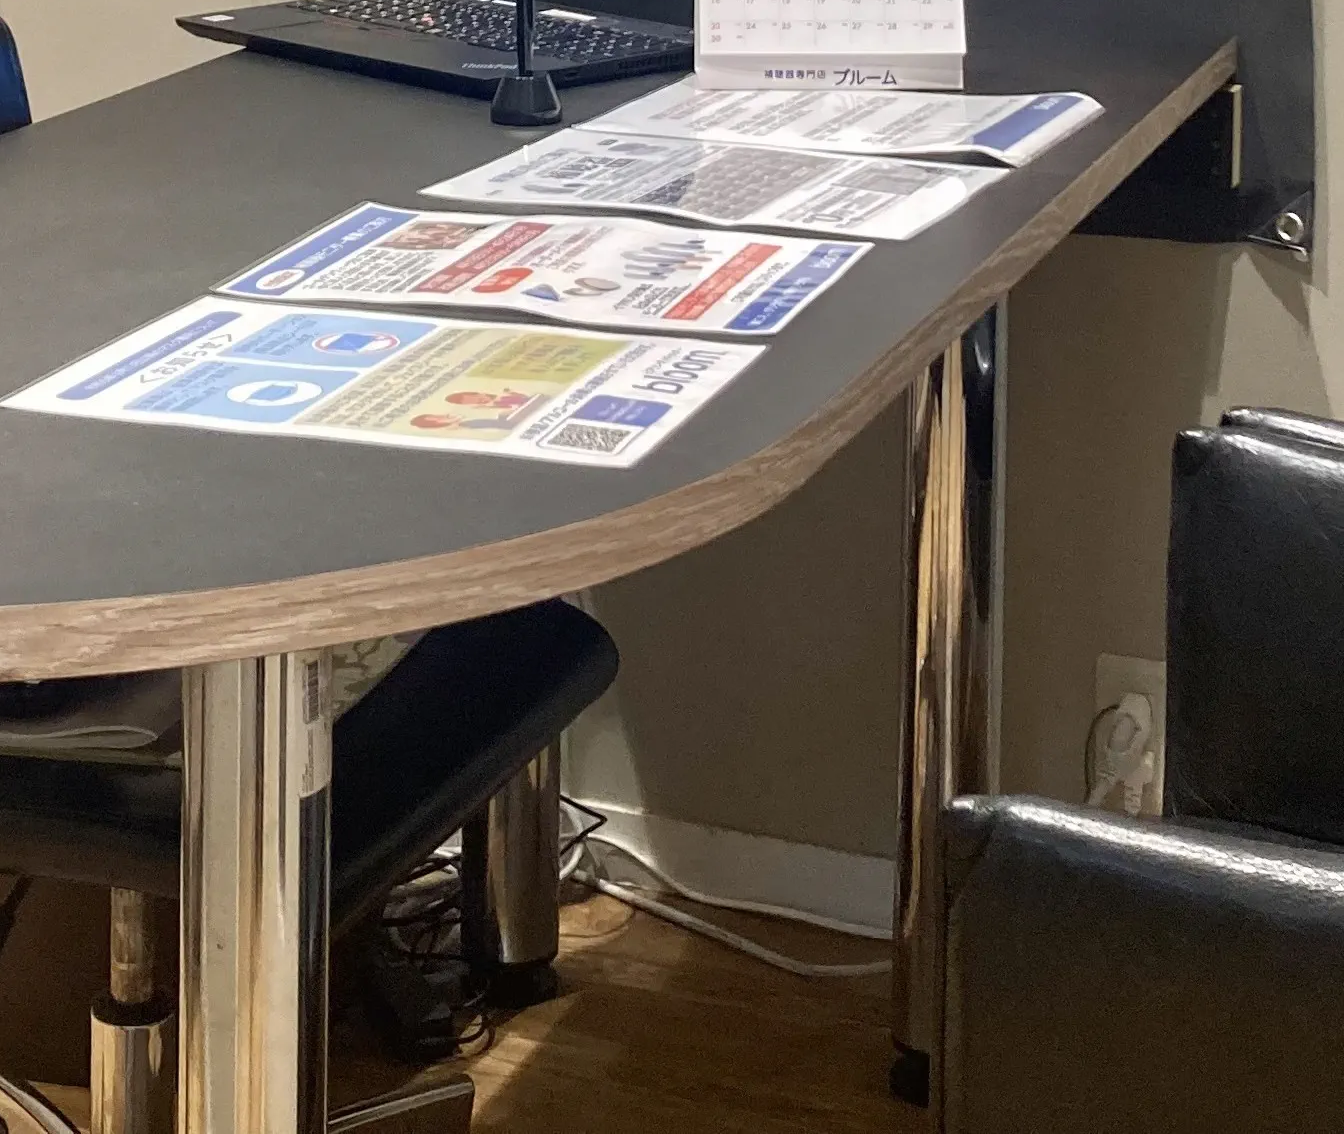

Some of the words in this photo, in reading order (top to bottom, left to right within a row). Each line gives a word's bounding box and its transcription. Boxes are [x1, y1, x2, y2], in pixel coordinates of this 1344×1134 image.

[833, 68, 897, 86] ブルーム
[632, 350, 729, 394] bloom
